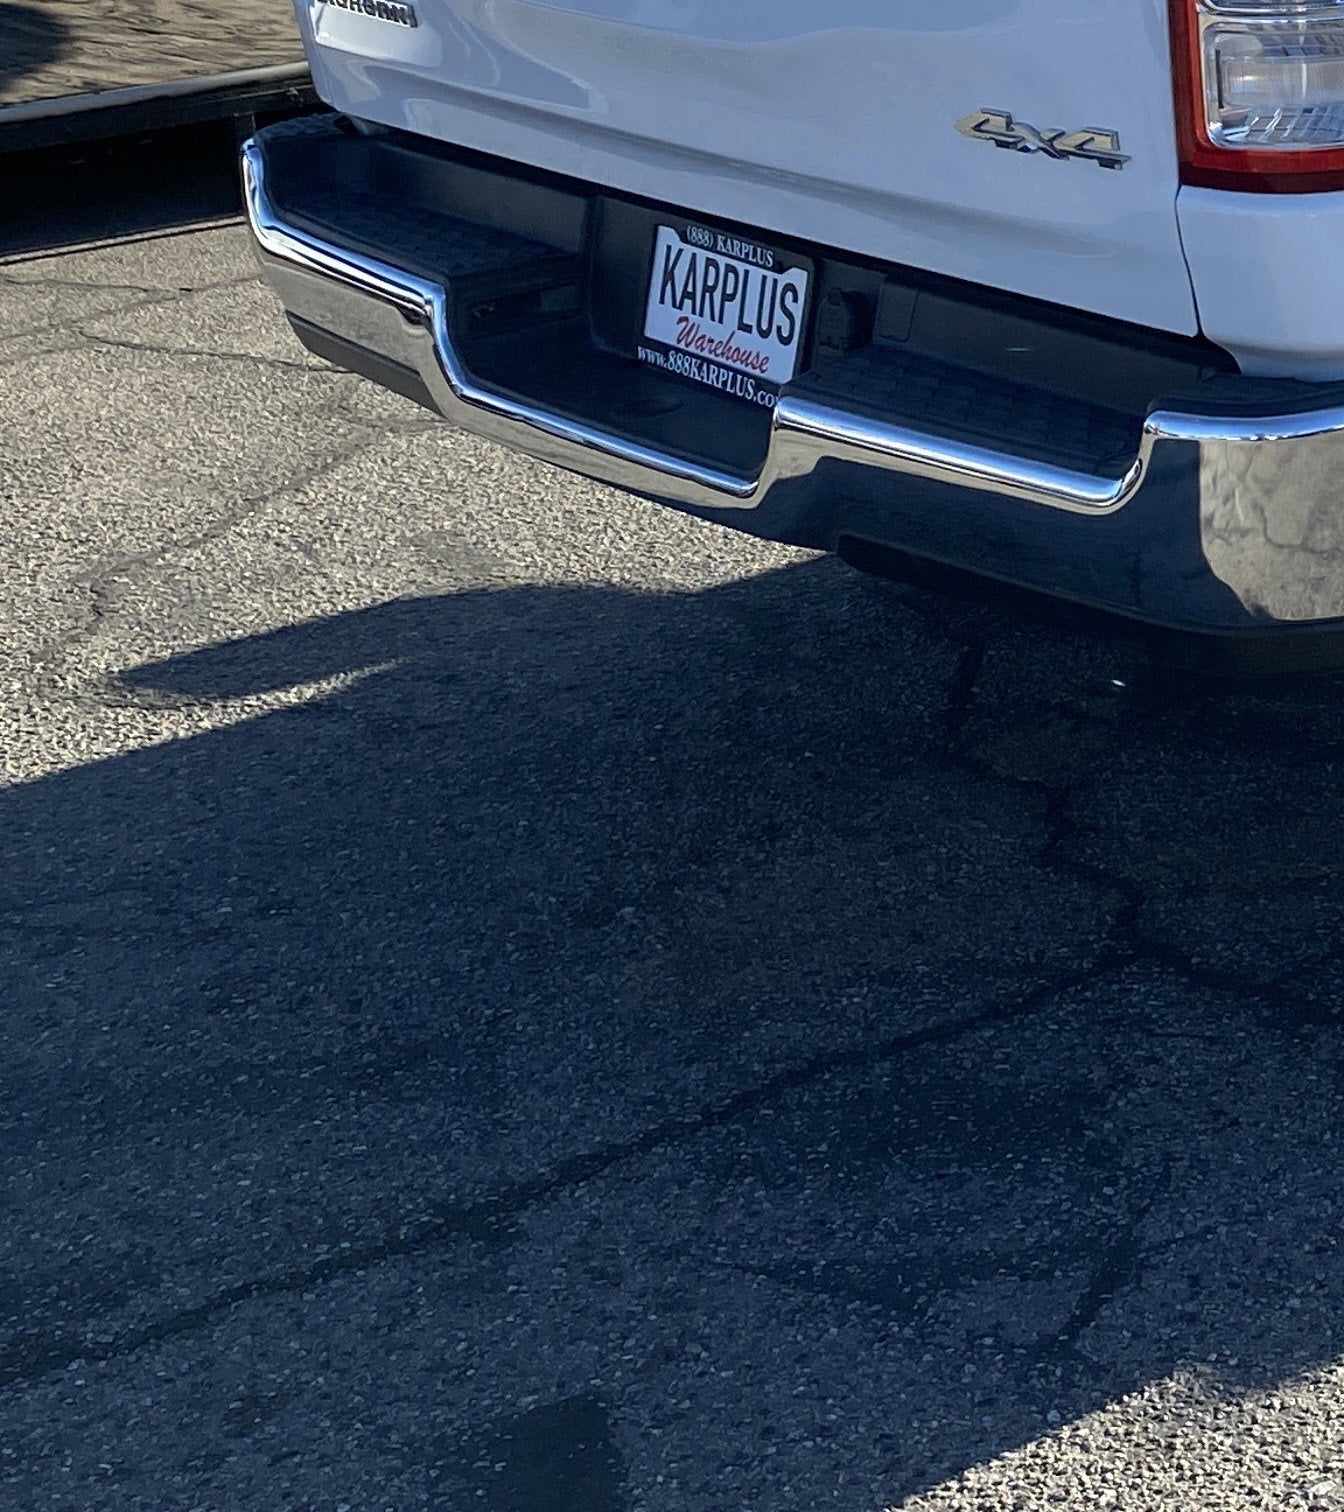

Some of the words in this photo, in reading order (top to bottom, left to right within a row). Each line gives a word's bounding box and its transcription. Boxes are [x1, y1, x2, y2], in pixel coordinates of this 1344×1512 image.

[685, 224, 714, 249] (888)
[716, 233, 775, 269] KARPLUS
[658, 244, 799, 346] KARPLUS
[675, 315, 770, 375] Warehouse
